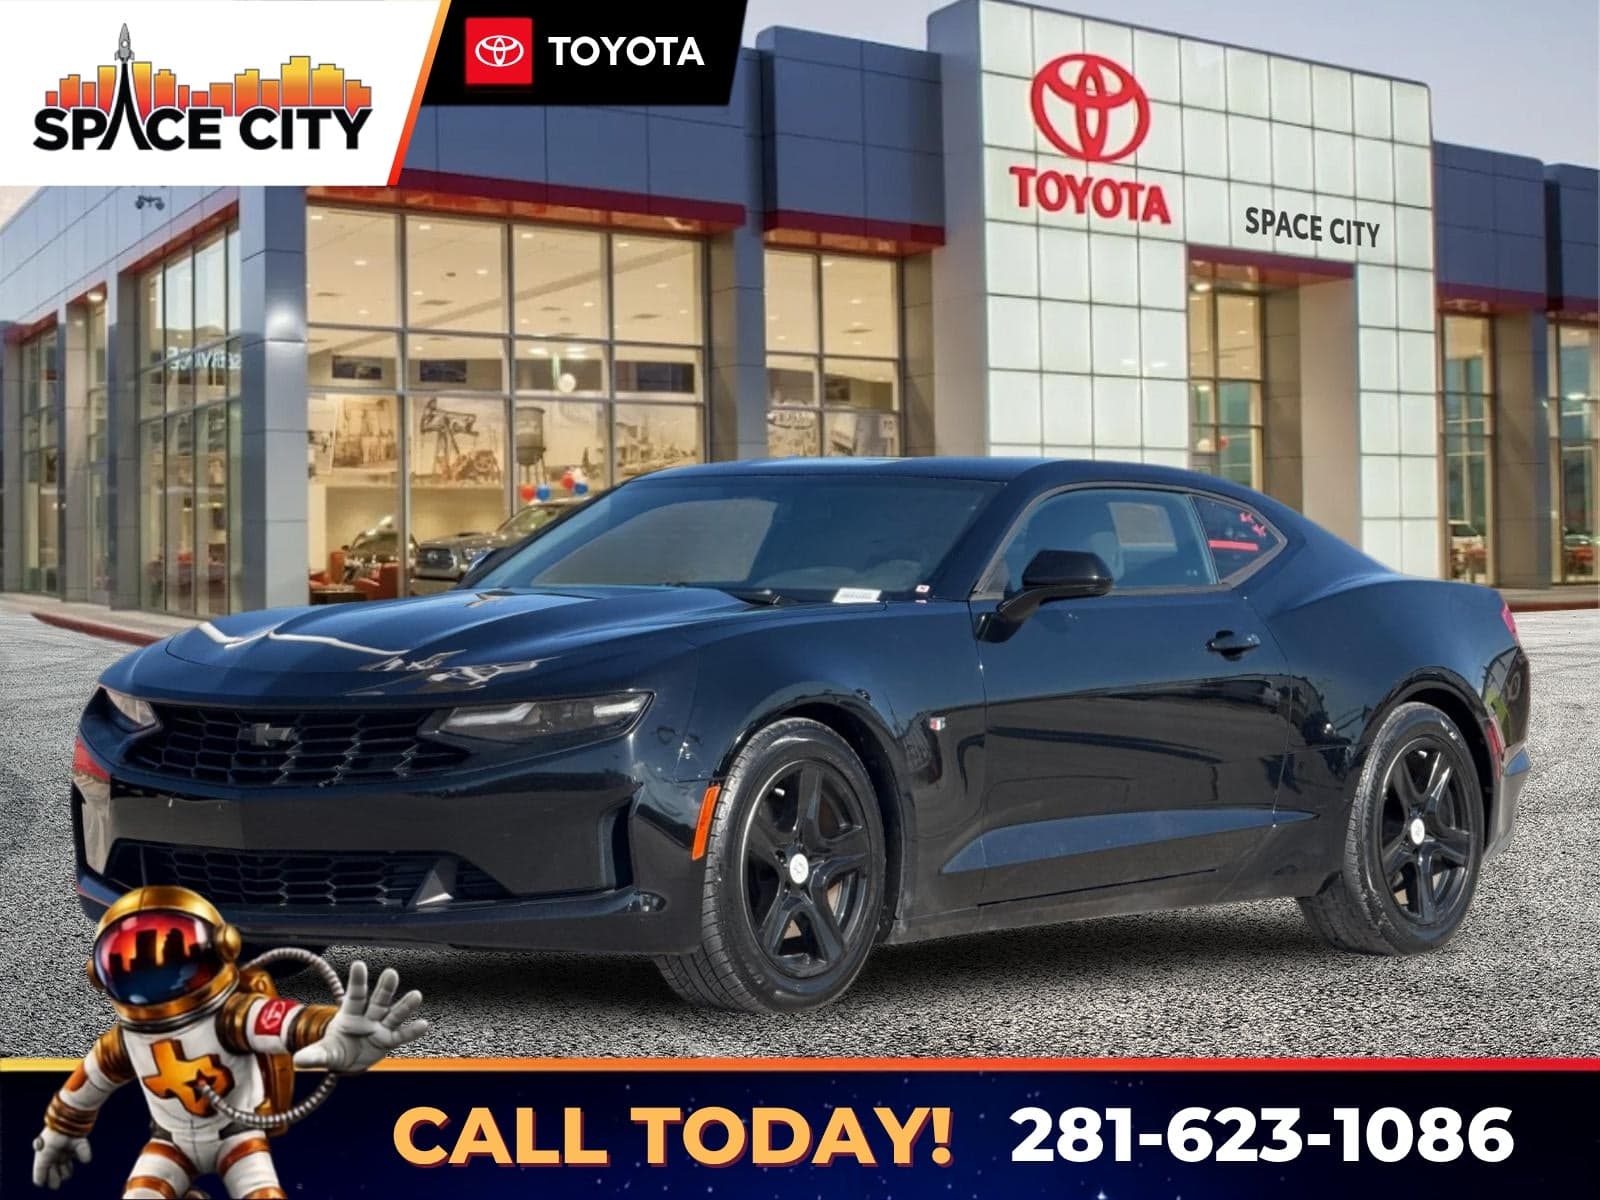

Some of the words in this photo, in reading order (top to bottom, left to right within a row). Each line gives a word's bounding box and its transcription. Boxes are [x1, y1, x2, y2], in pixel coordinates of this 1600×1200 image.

[1009, 166, 1171, 224] TOYOTA
[1245, 205, 1322, 242] SPACE
[1330, 218, 1381, 248] CITY
